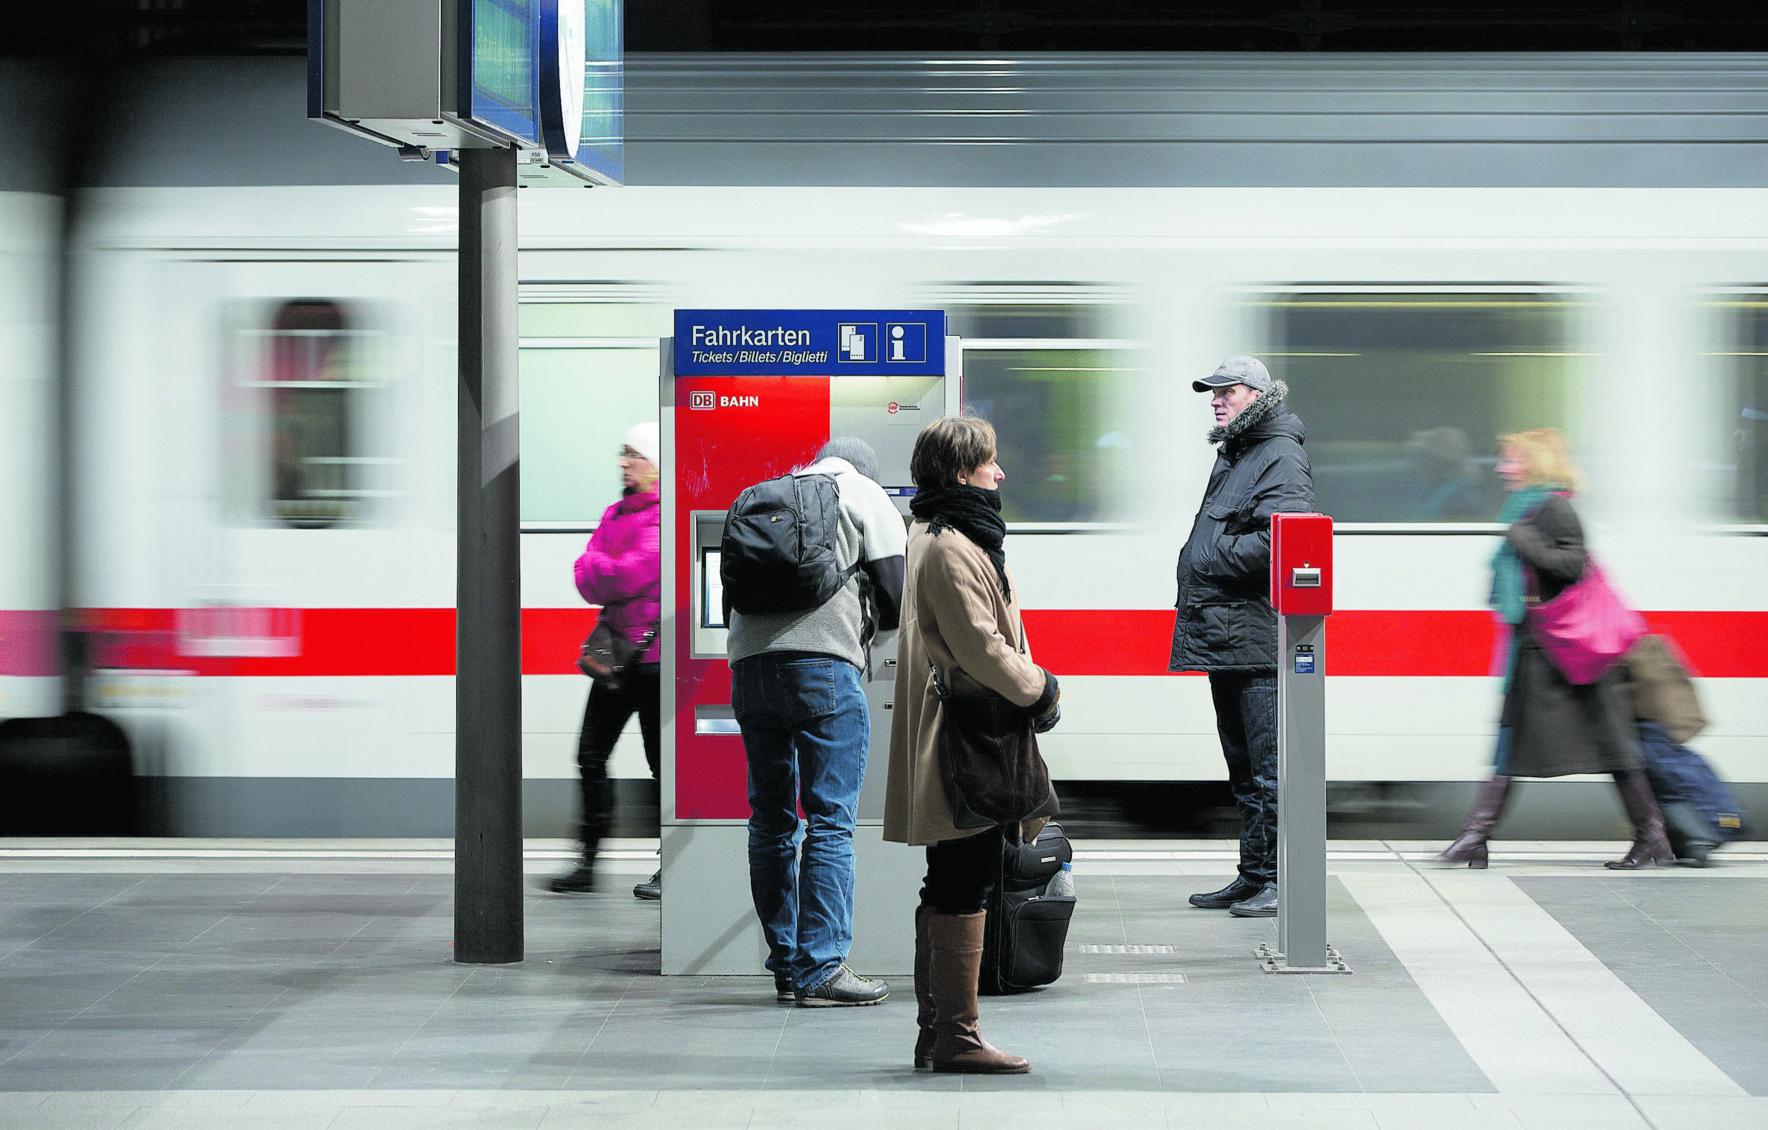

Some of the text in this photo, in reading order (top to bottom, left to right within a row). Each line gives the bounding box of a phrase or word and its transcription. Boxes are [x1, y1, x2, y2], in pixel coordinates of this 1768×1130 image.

[692, 325, 810, 346] Fahrkarten
[692, 393, 759, 408] DB BAHN
